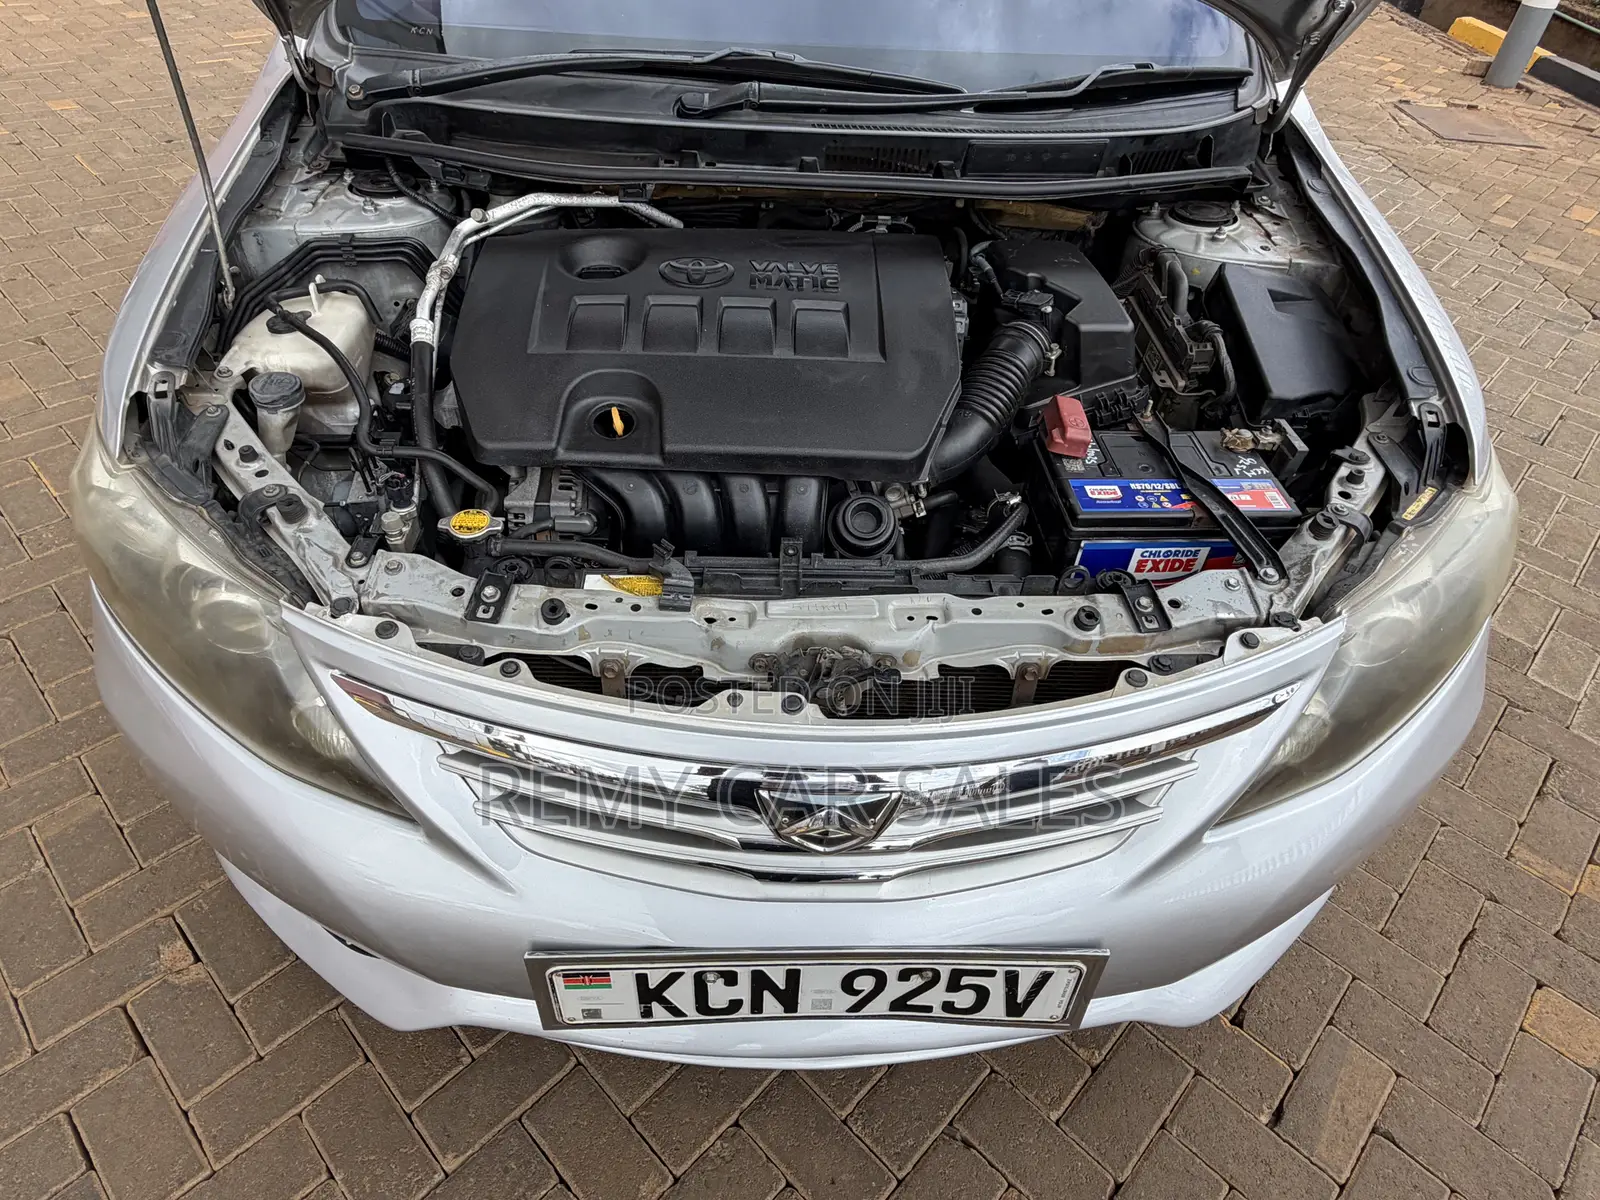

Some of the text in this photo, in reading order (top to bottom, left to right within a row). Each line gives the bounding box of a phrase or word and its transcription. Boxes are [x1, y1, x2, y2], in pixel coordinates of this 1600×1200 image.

[411, 26, 433, 35] KCN
[749, 260, 838, 275] VALVE
[749, 273, 840, 292] MATIC
[1140, 549, 1201, 558] CHLORIDE
[1134, 558, 1198, 572] EXIDE
[634, 968, 801, 1019] KCN
[840, 967, 1055, 1017] 925V
